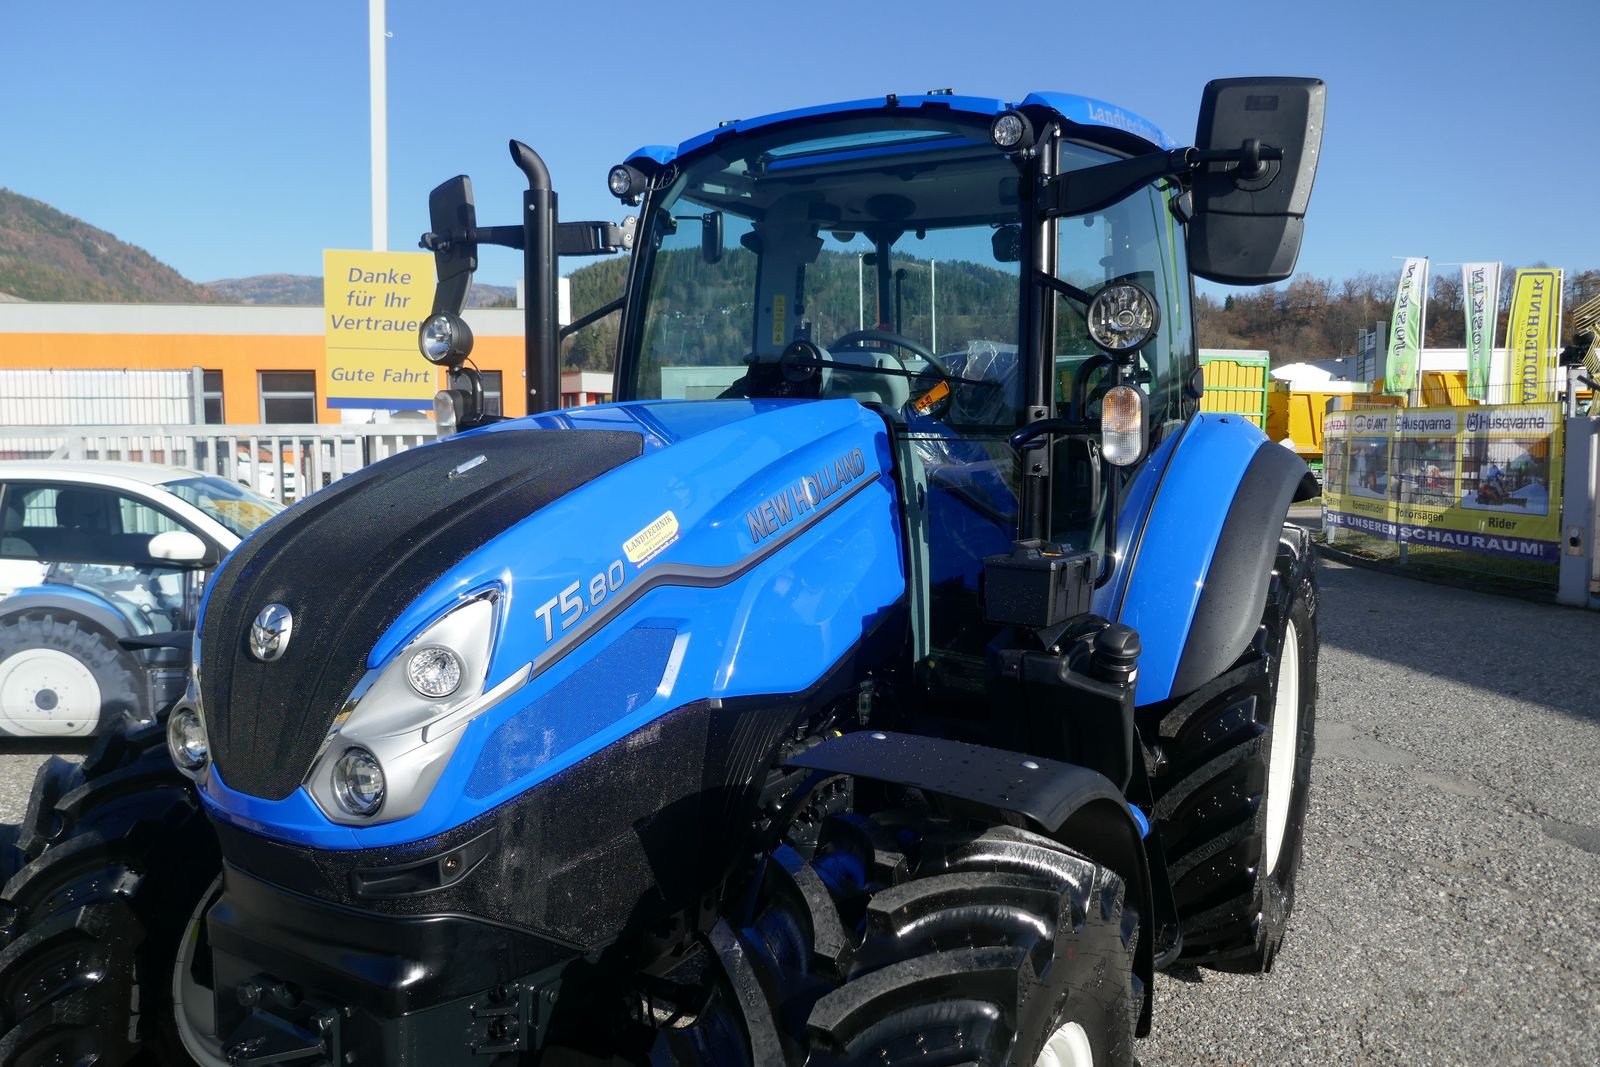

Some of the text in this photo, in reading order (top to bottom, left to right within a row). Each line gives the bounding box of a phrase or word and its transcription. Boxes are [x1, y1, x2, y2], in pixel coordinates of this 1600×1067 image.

[349, 267, 412, 285] Danke
[346, 290, 411, 308] für Ihr
[331, 367, 431, 384] Gute Fahrt
[1402, 417, 1452, 433] Husqvarna
[1479, 415, 1545, 432] Husqvarna
[745, 490, 794, 545] NEW
[790, 448, 867, 516] HOLLAND
[1488, 517, 1518, 530] Rider
[625, 514, 674, 553] LANDTECHNIK
[1327, 513, 1544, 557] SIE UNSEREN SCHAURAUM!
[534, 559, 626, 643] T5.80
